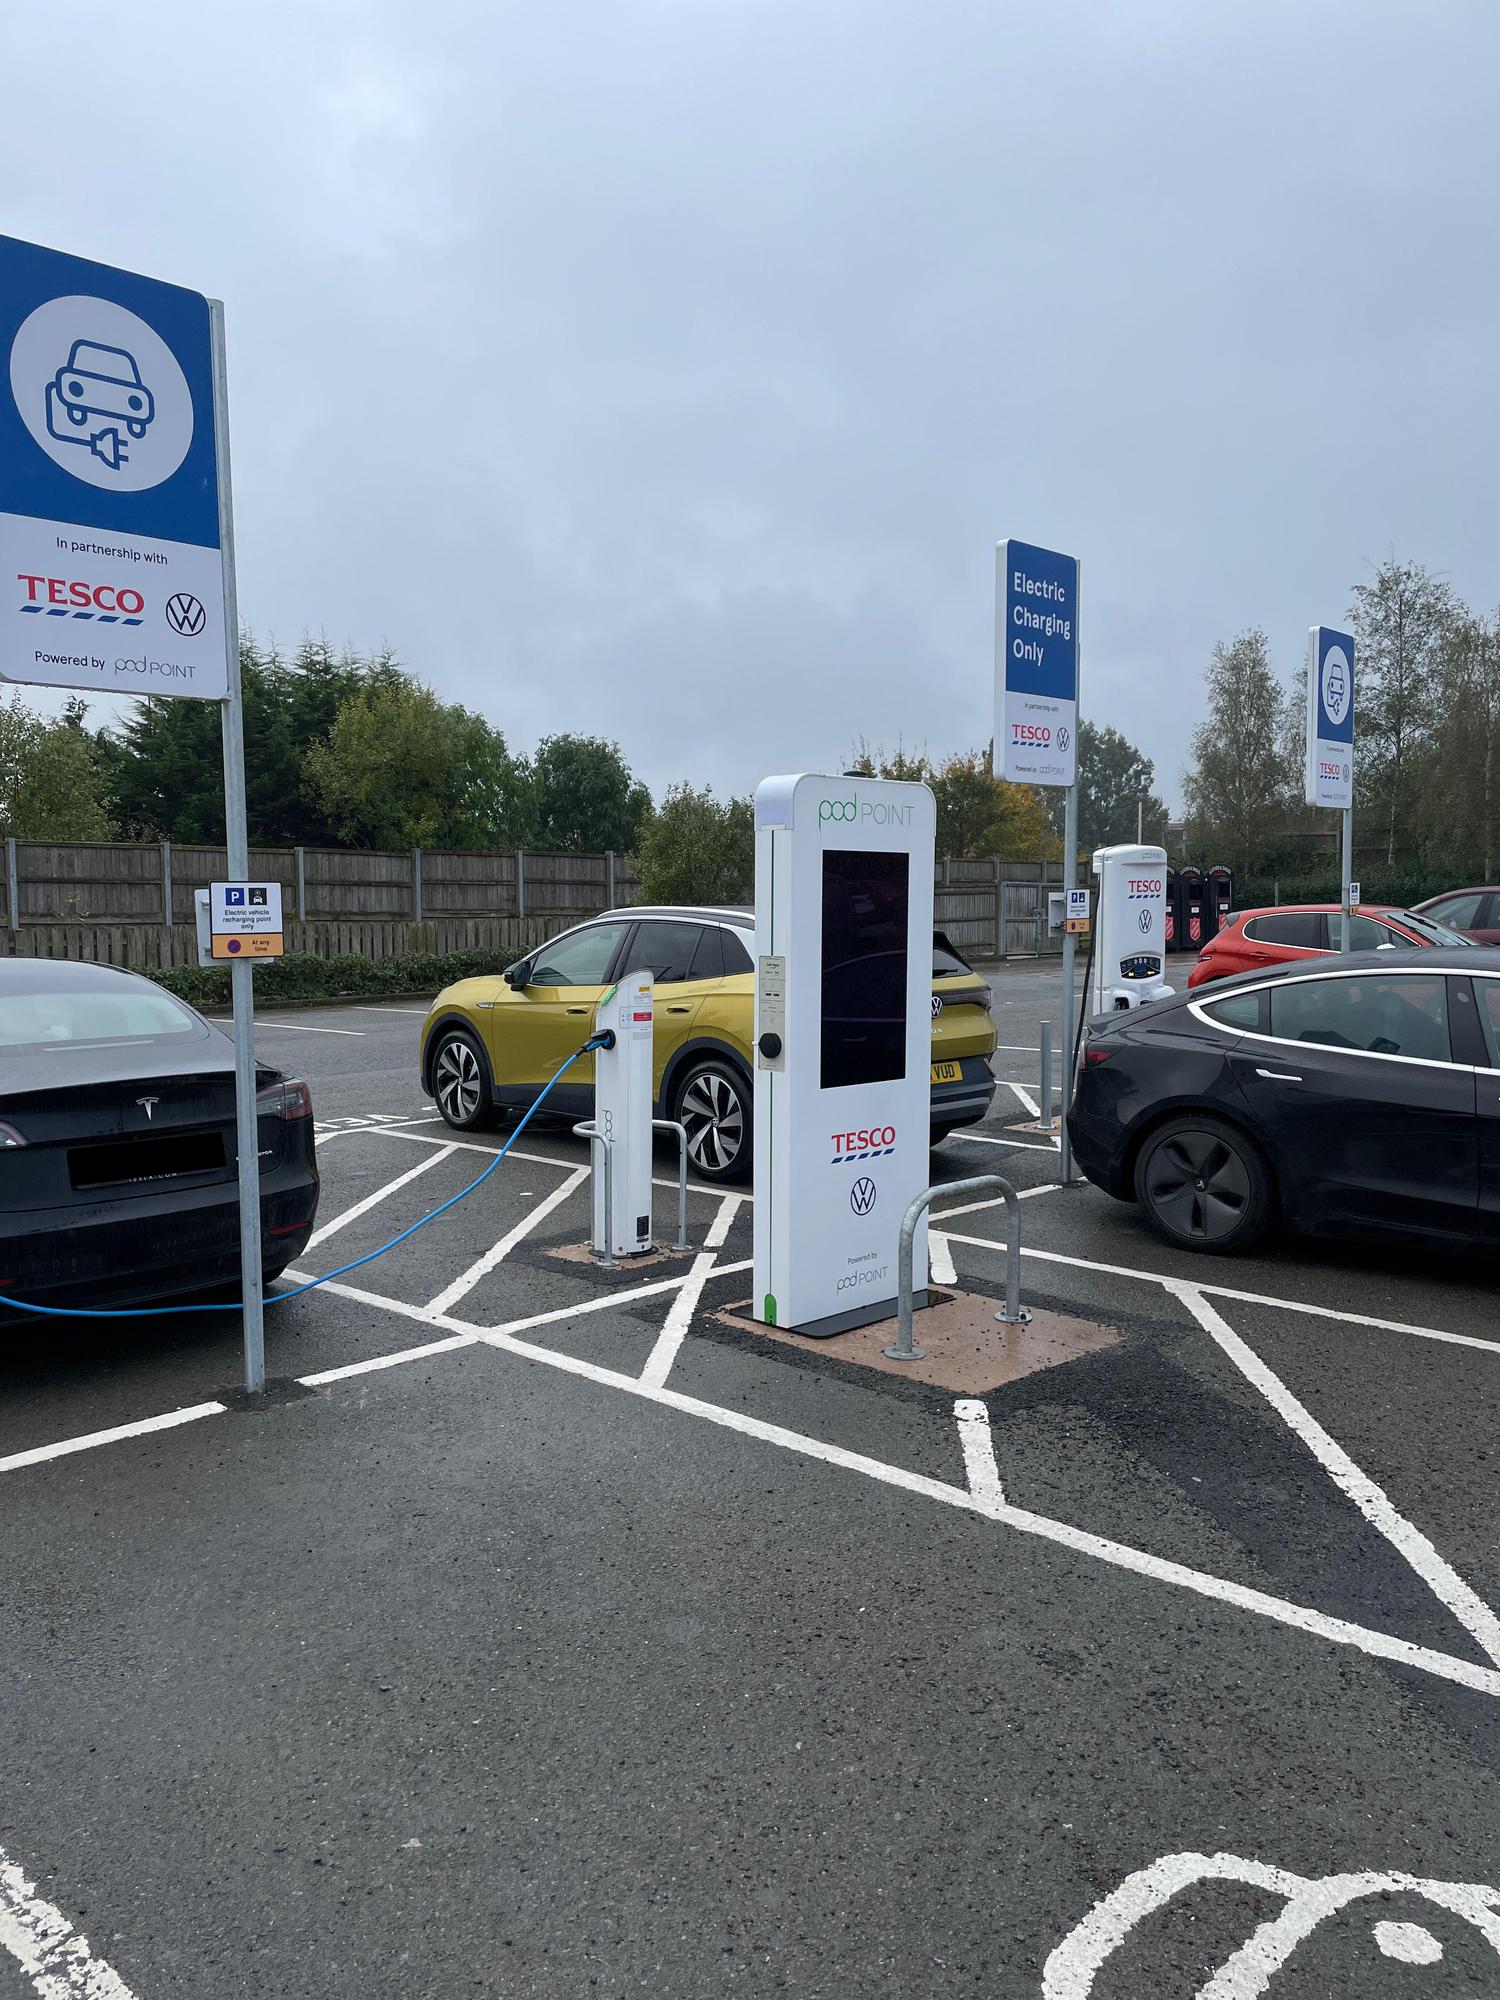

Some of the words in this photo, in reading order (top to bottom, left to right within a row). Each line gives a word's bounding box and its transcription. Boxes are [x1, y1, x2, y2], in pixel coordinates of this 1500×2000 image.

[55, 536, 69, 550] In
[71, 540, 141, 563] partnership
[143, 551, 168, 565] with
[17, 573, 145, 615] TESCO
[1014, 571, 1065, 602] Electric
[1013, 605, 1071, 641] Charging
[34, 650, 88, 668] Powered
[90, 656, 106, 671] by
[114, 656, 147, 676] pod
[149, 661, 196, 679] POINT
[1013, 638, 1044, 667] Only
[1012, 724, 1051, 742] TESCO
[1319, 762, 1341, 776] TESCO
[818, 792, 857, 830] pod
[861, 801, 916, 826] POINT
[231, 891, 240, 903] P
[1128, 880, 1162, 893] TESCO
[831, 1126, 897, 1154] TESCO
[848, 1253, 870, 1265] Powered
[836, 1270, 858, 1296] pod
[859, 1266, 888, 1285] POINT
